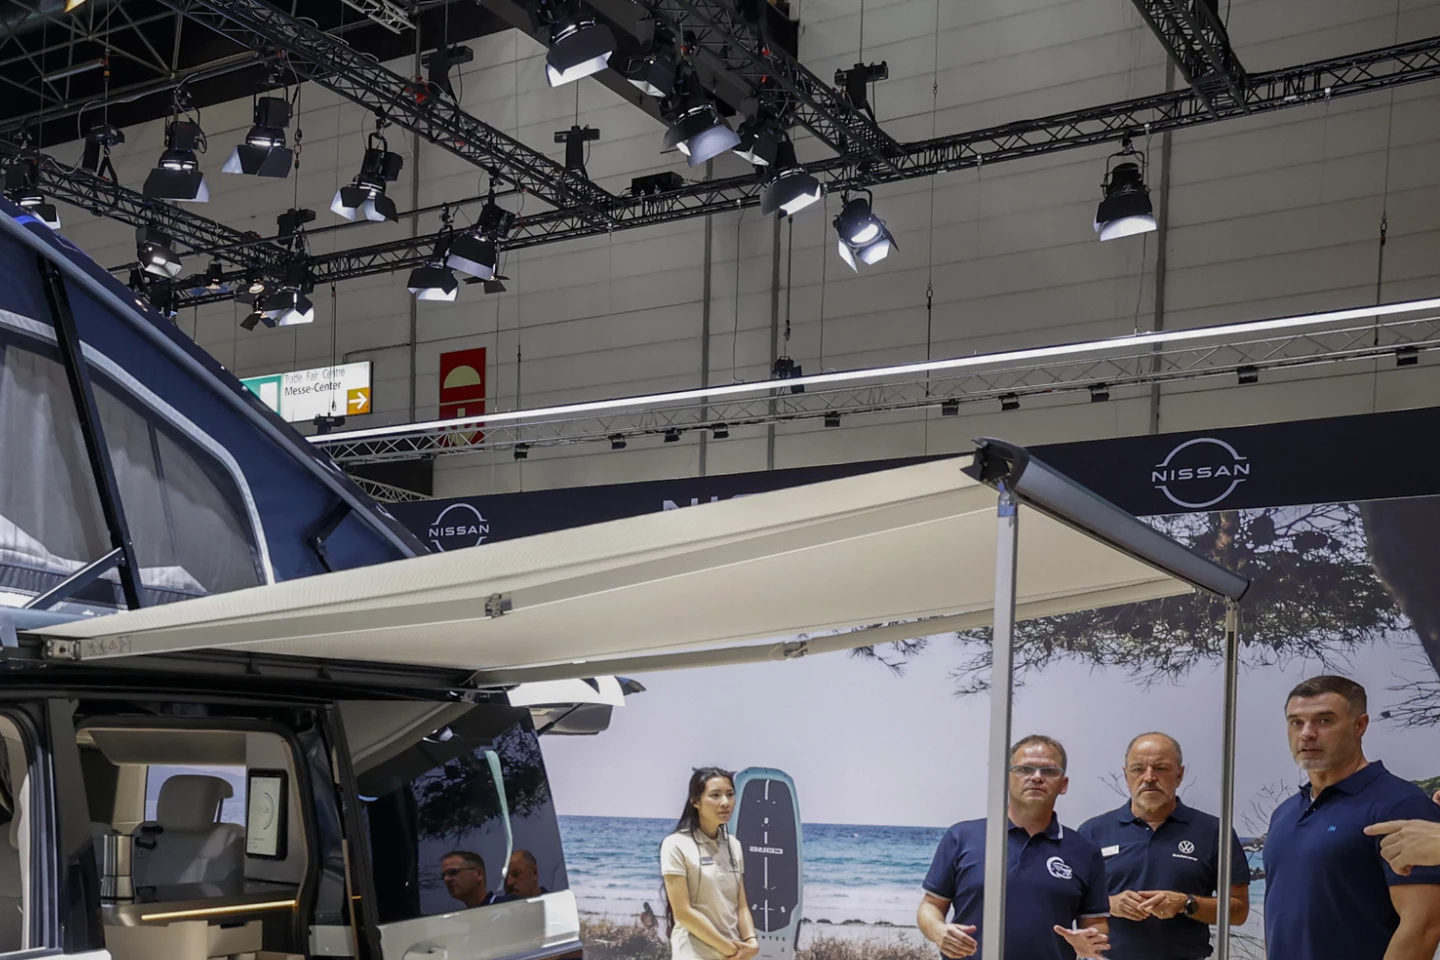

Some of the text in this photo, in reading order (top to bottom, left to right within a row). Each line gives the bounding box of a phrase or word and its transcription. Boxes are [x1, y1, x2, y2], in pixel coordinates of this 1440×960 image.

[306, 370, 319, 381] Fair
[284, 381, 342, 397] Messe-Center
[1151, 463, 1250, 483] NISSAN
[428, 524, 490, 538] NISSAN
